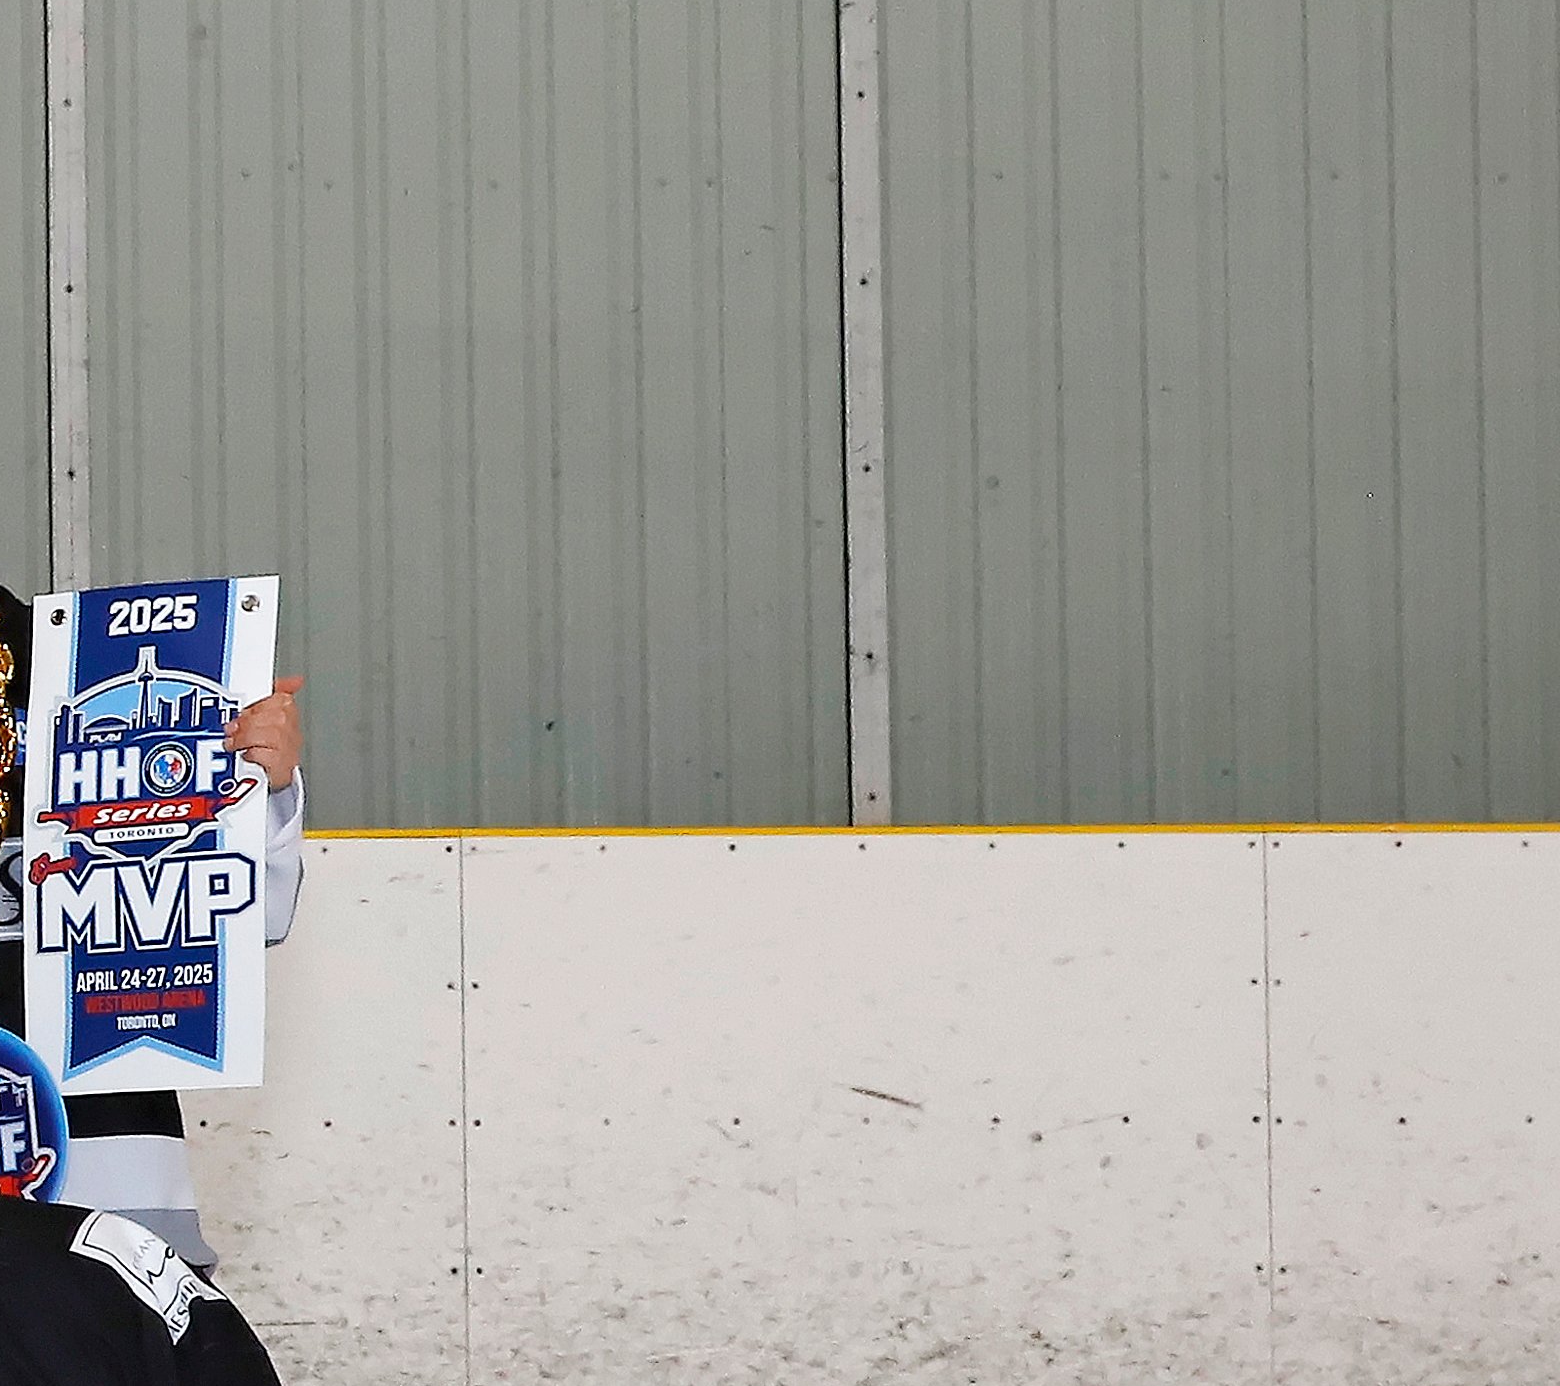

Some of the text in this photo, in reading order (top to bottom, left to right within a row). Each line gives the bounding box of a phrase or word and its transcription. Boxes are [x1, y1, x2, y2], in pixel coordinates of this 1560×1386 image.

[108, 595, 198, 637] 2025
[57, 739, 227, 805] HHOF
[109, 826, 174, 839] TORONTO
[38, 856, 254, 951] MVP
[76, 963, 213, 992] APRIL 24-27, 2025
